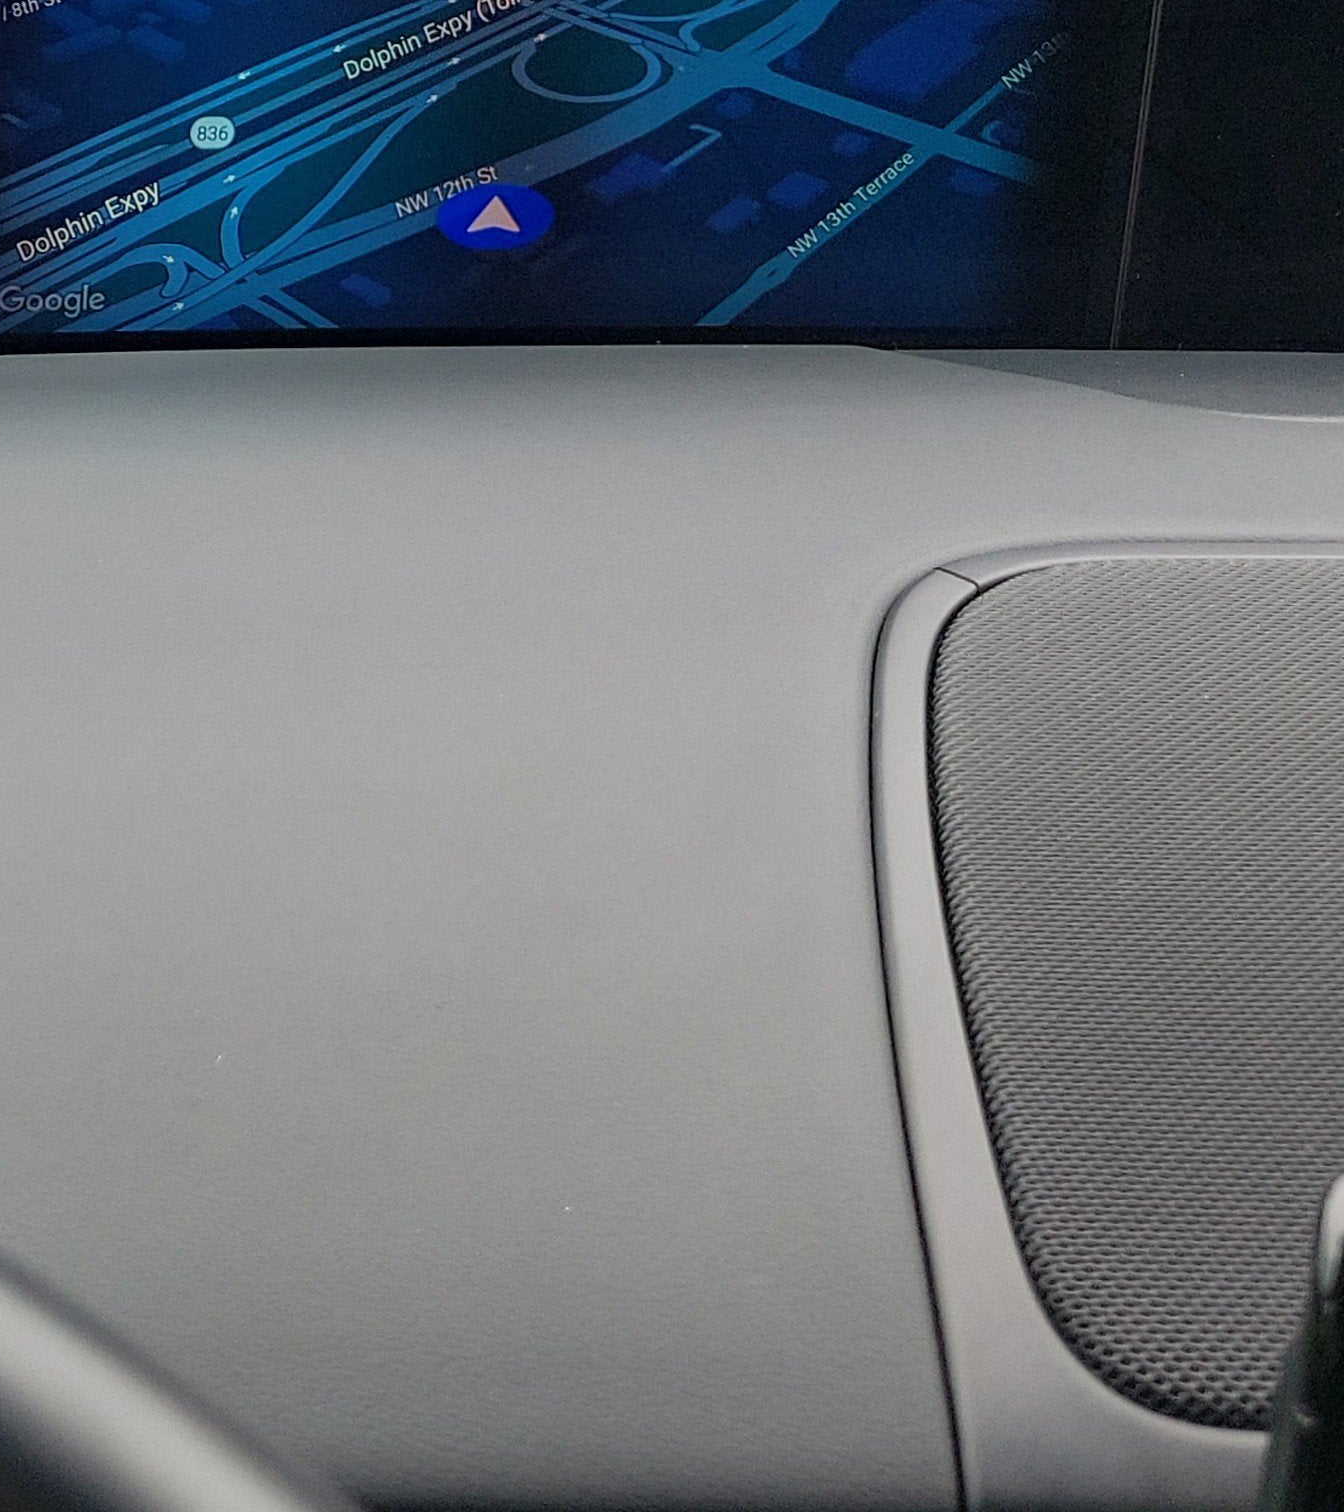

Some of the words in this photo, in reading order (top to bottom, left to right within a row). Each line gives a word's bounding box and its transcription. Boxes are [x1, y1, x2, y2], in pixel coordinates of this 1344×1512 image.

[343, 35, 422, 81] Dolphin
[423, 9, 473, 44] Expy
[1001, 58, 1033, 90] NW
[196, 125, 229, 142] 836
[15, 211, 104, 262] Dolphin
[104, 181, 162, 220] Expy
[395, 191, 429, 217] NW
[433, 174, 474, 200] 12th
[476, 165, 499, 185] St
[787, 228, 818, 258] NW
[818, 202, 856, 232] 13th
[853, 153, 914, 201] Terrace
